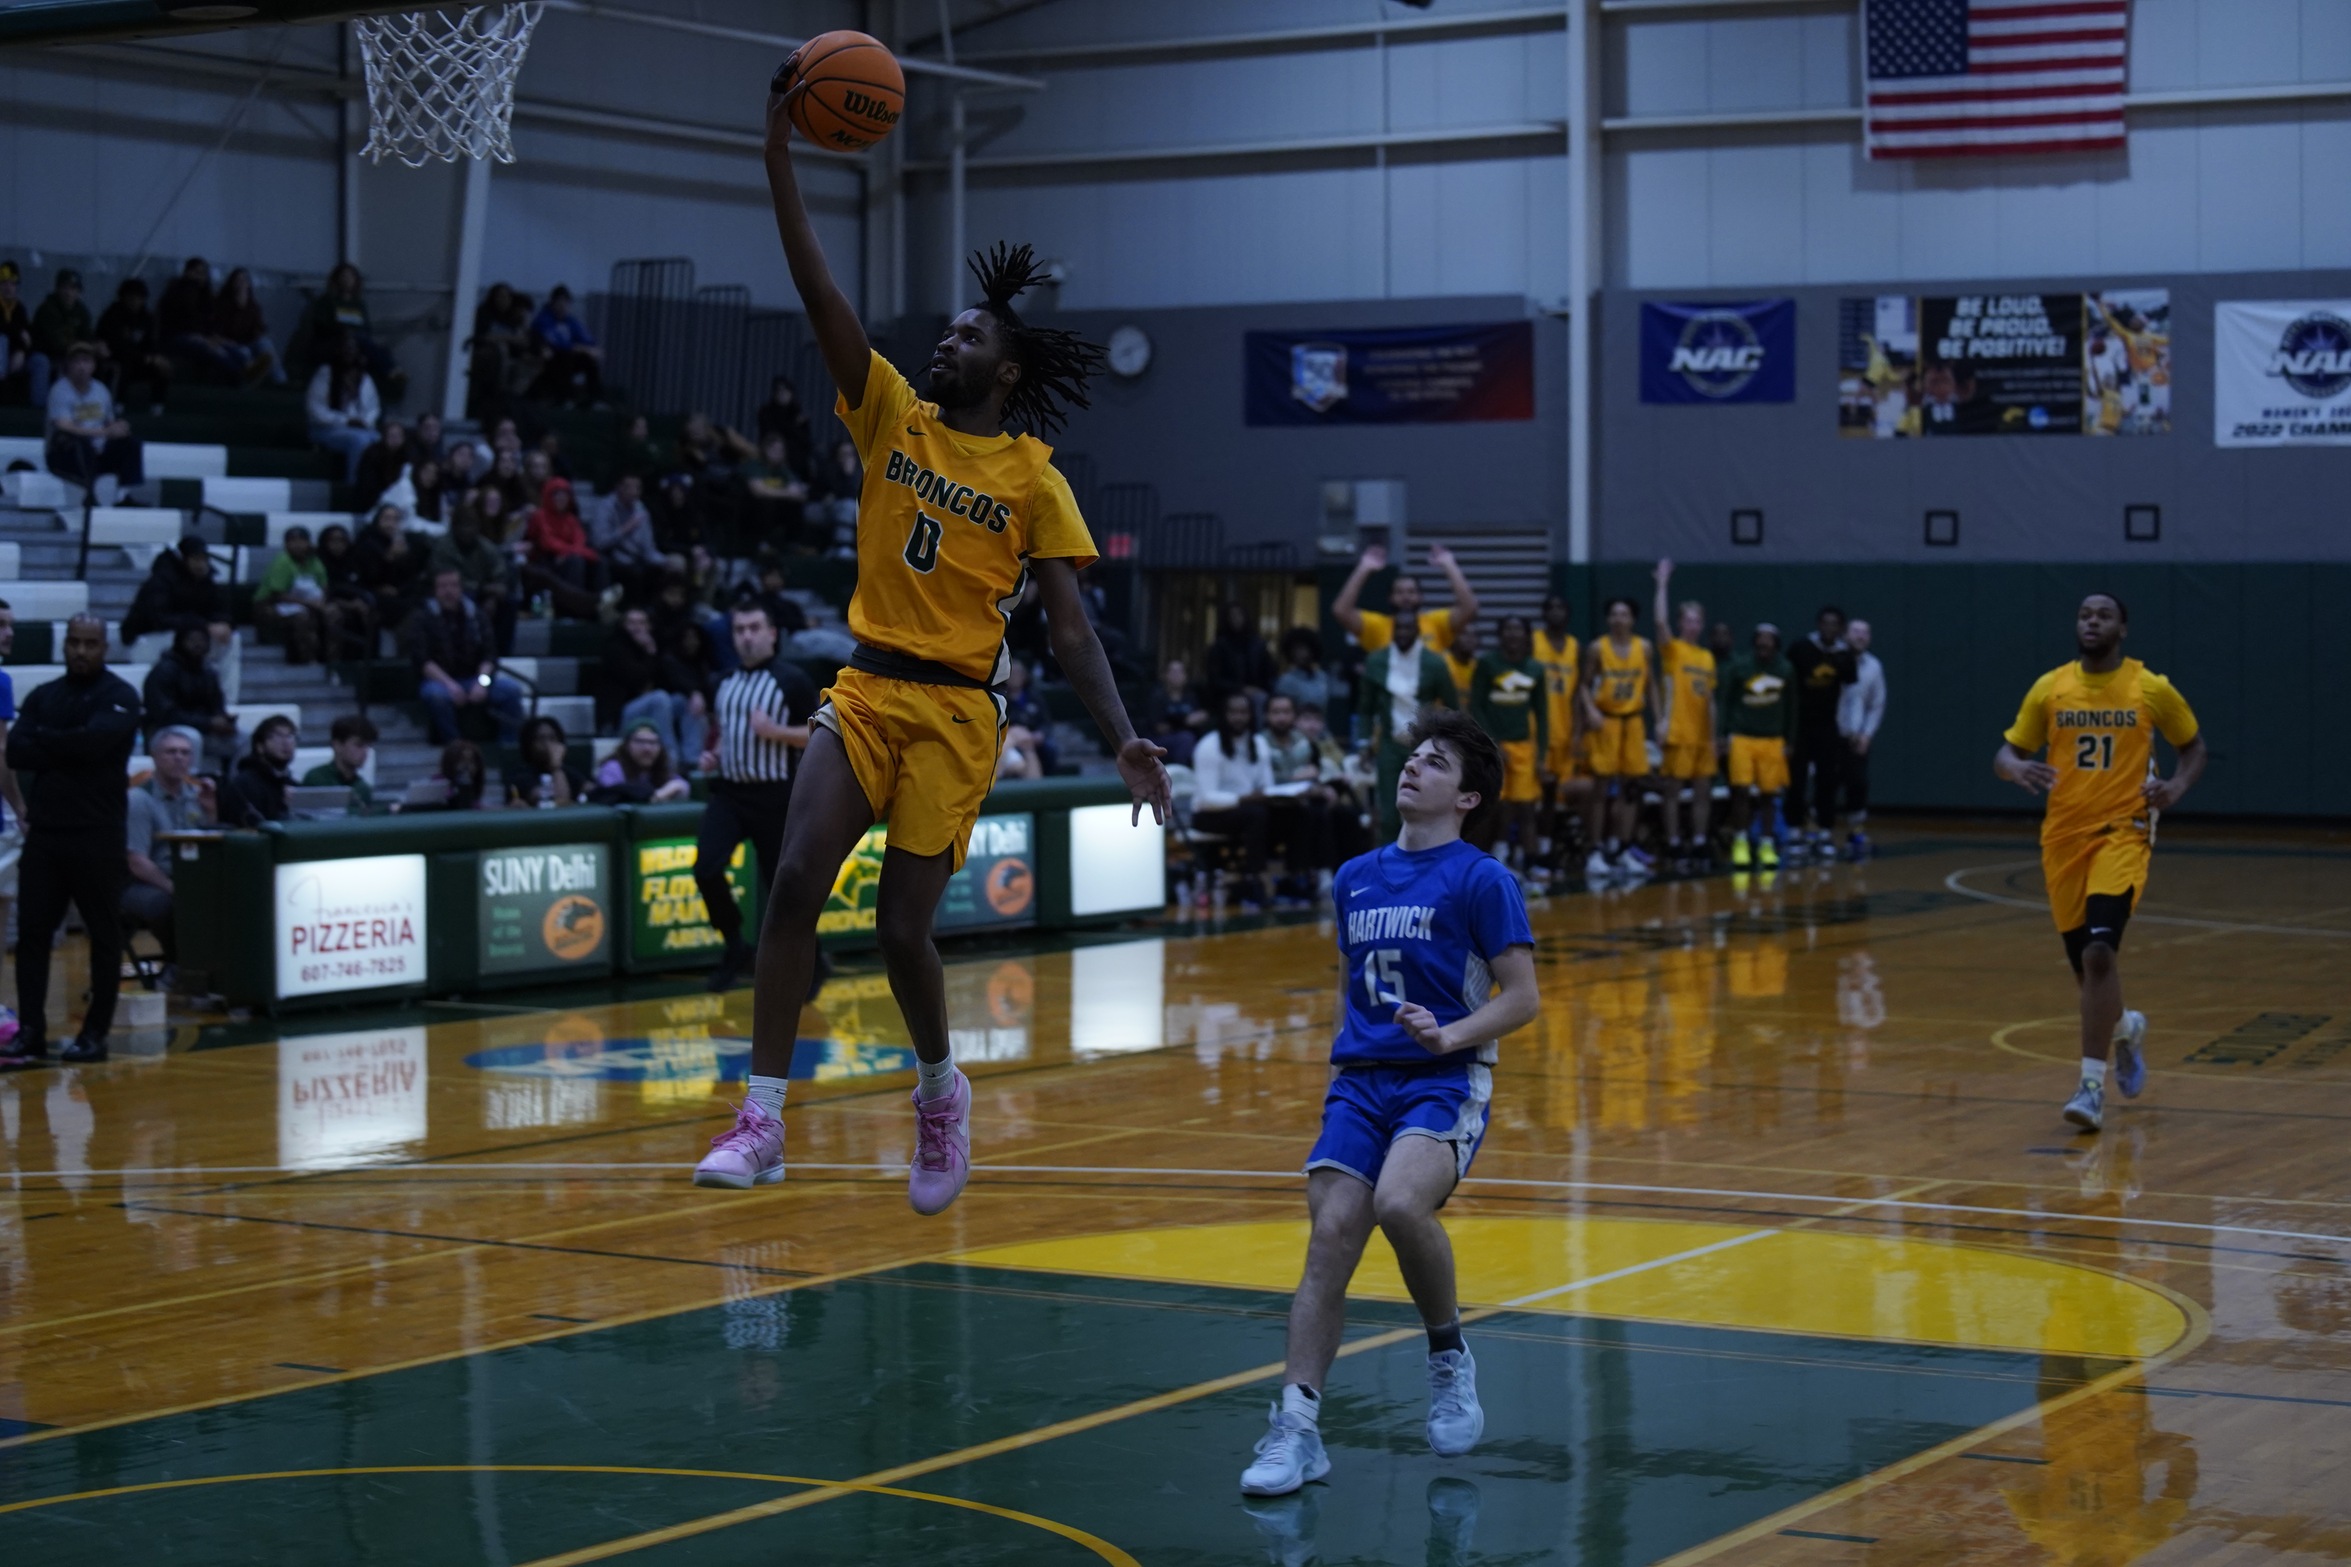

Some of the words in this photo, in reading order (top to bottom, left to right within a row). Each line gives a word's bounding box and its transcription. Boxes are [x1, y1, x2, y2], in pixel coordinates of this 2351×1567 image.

[1955, 296, 1983, 317] BE
[1947, 317, 1976, 338] BE
[1668, 345, 1766, 372] NAC
[1937, 337, 1965, 359] BE
[1967, 335, 2067, 359] POSITIVE!
[2233, 422, 2283, 438] 2022
[884, 449, 1012, 534] BRONCOS
[902, 509, 944, 575] 0
[2055, 709, 2138, 729] BRONCOS
[2075, 735, 2115, 770] 21
[485, 856, 546, 896] SUNY
[549, 853, 597, 891] Delhi
[291, 917, 416, 956] PIZZERIA
[1348, 905, 1437, 946] HARTWICK
[1364, 948, 1407, 1008] 15
